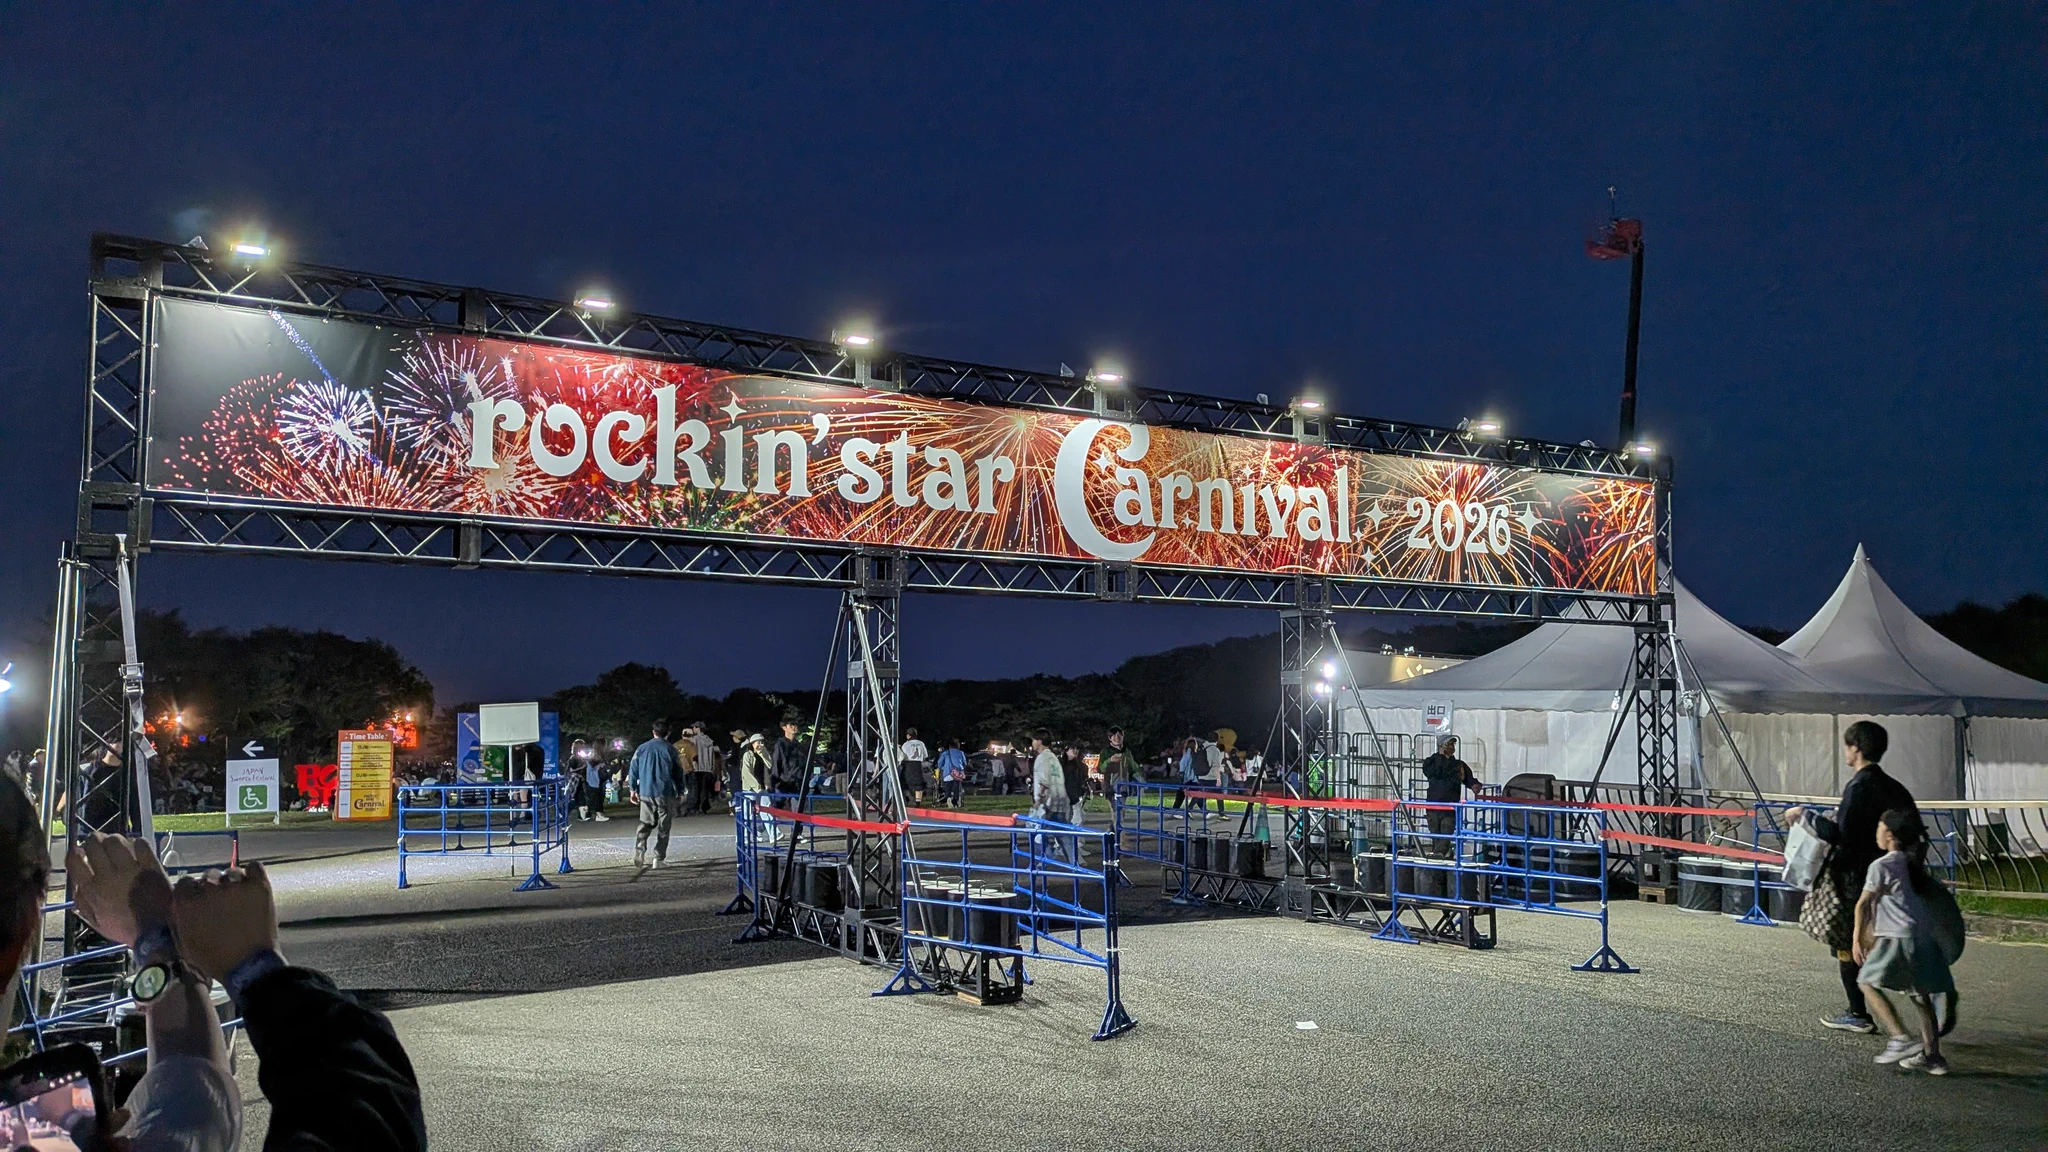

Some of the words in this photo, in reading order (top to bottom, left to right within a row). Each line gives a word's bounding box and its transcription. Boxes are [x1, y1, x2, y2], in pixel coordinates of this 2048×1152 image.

[1053, 419, 1353, 561] Carnival
[1406, 495, 1512, 556] 2026
[1427, 705, 1446, 716] 出口
[542, 772, 556, 780] Map
[354, 798, 385, 810] Carnival
